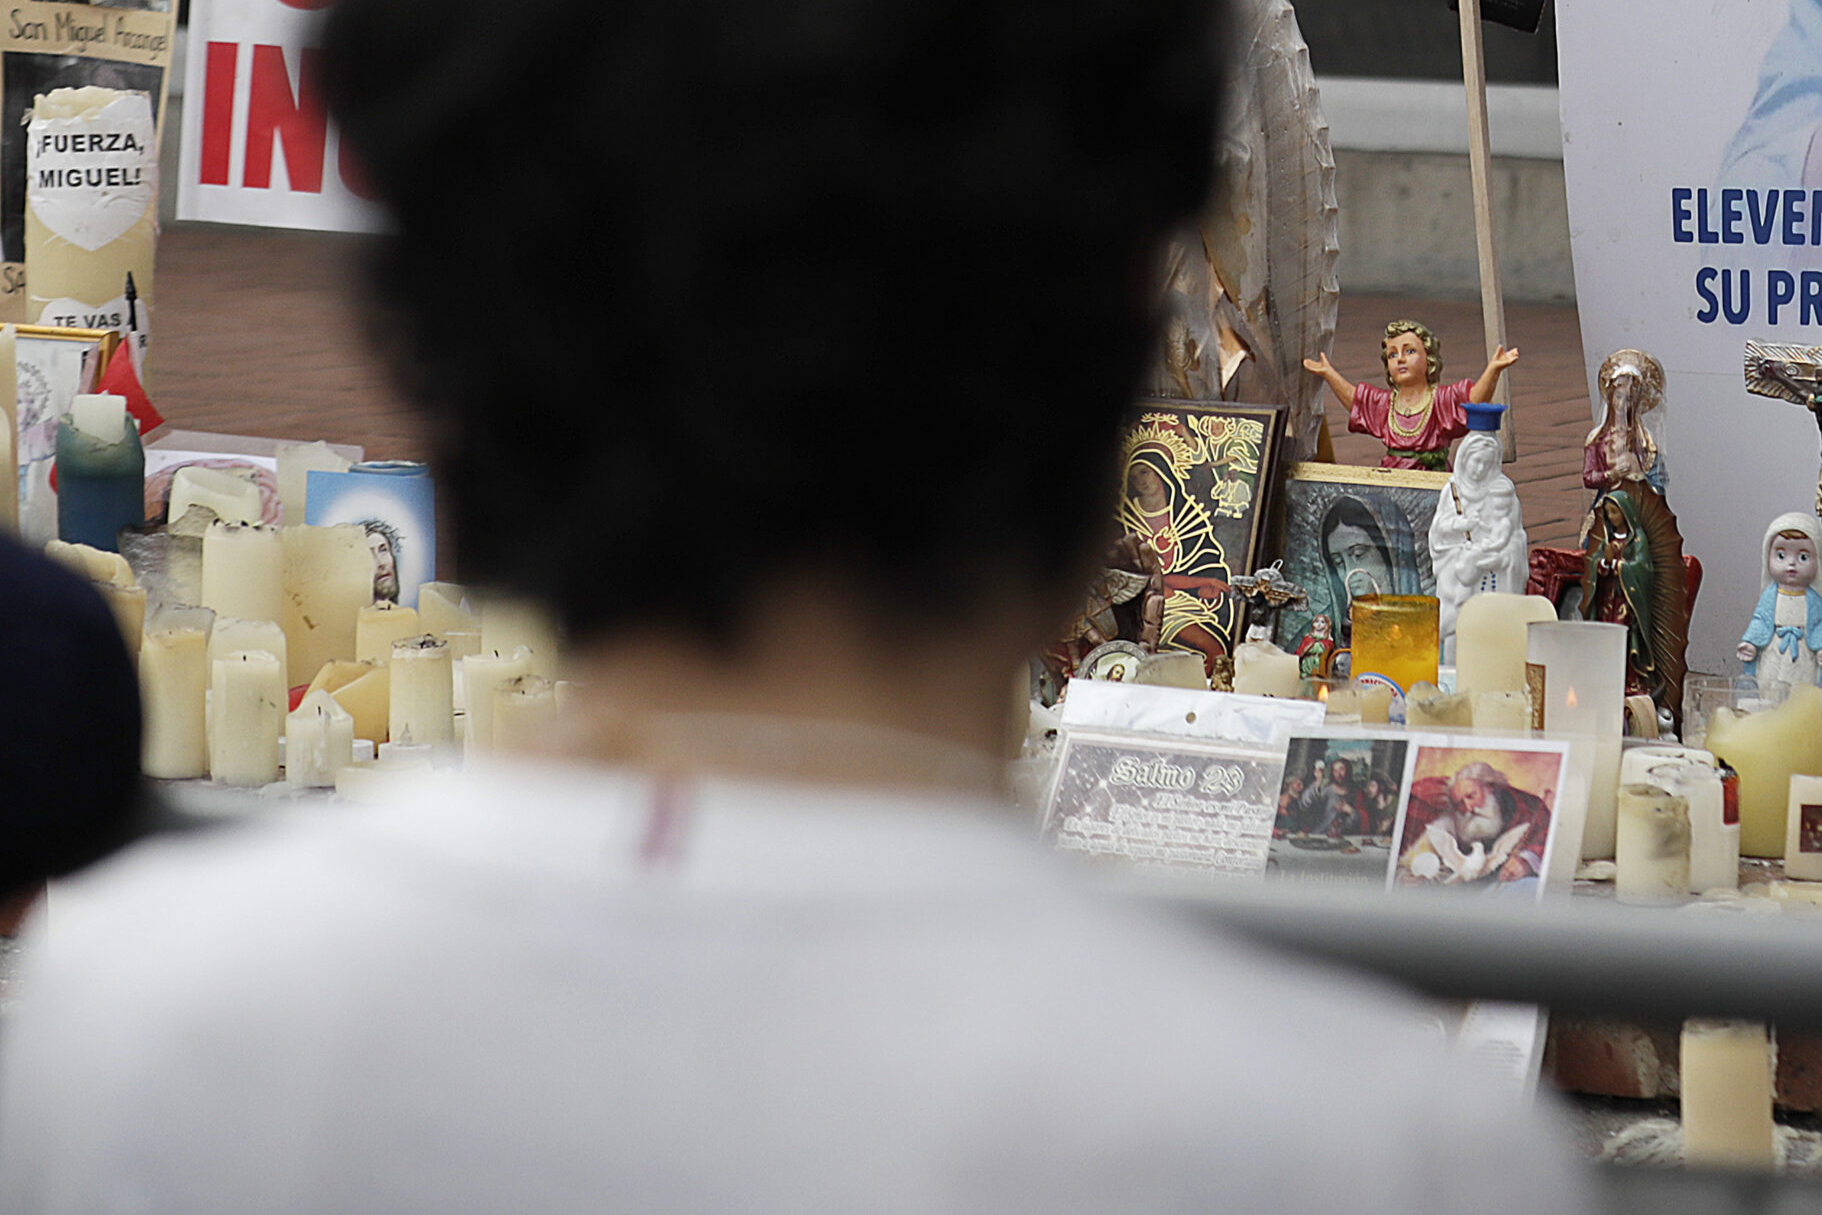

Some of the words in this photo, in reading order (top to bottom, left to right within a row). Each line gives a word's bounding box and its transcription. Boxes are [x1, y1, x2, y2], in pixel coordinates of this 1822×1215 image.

[9, 8, 48, 39] San
[54, 11, 108, 53] Miguel
[39, 167, 141, 189] MIGUEL!
[1696, 266, 1751, 325] SU
[54, 314, 78, 329] TE
[83, 312, 122, 329] VAS
[1110, 755, 1196, 791] Salmo
